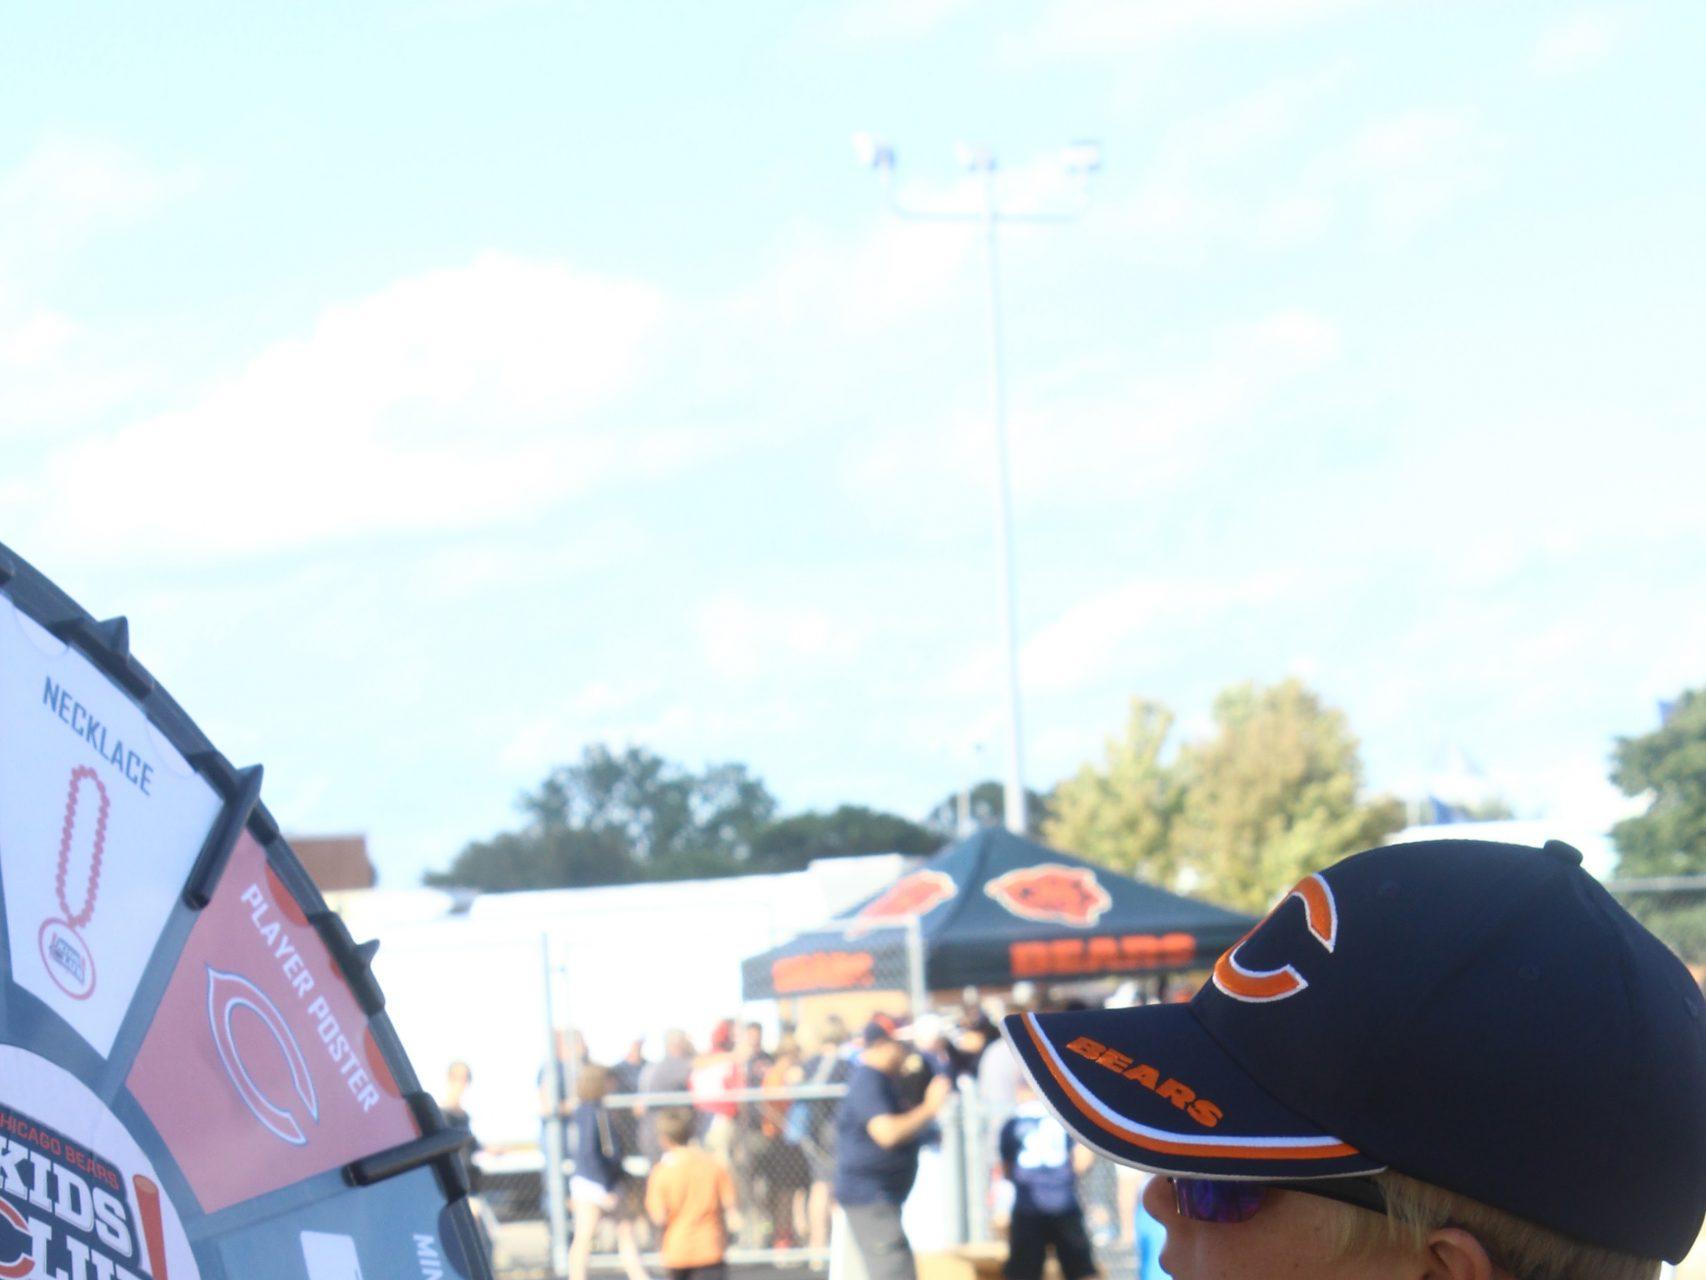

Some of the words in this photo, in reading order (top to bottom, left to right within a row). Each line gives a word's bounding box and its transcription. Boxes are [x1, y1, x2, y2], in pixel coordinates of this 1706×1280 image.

[42, 675, 154, 796] NECKLACE
[240, 883, 315, 998] PLAYER
[307, 996, 380, 1112] POSTER
[1212, 872, 1338, 1003] C
[1066, 1036, 1224, 1128] BEARS
[0, 1111, 62, 1156] HICAGO
[65, 1144, 120, 1191] BEARS
[0, 1134, 133, 1259] KIDS
